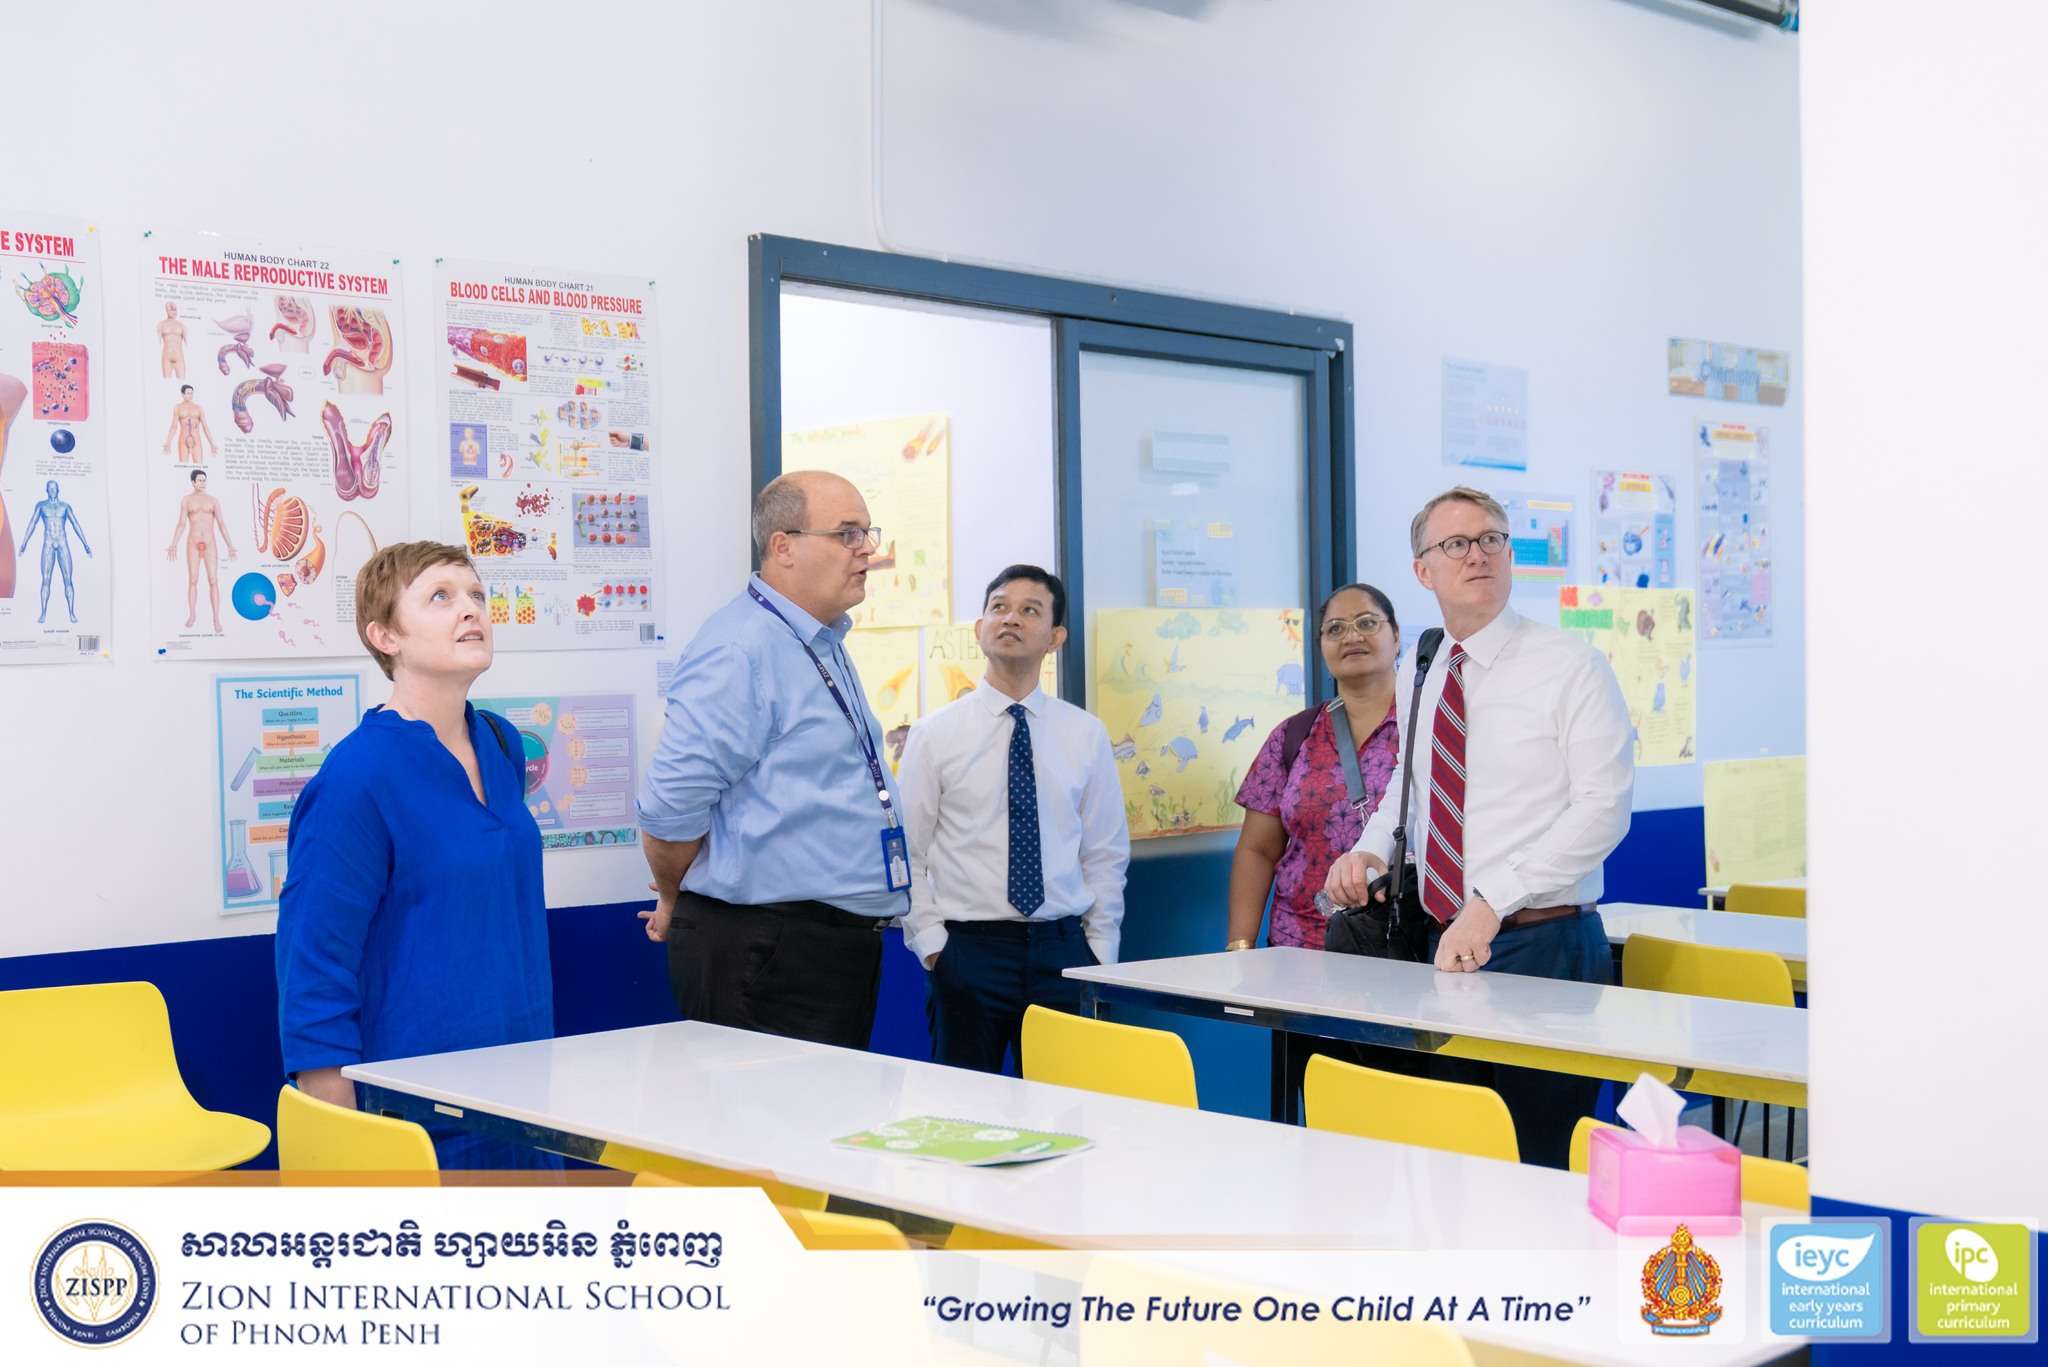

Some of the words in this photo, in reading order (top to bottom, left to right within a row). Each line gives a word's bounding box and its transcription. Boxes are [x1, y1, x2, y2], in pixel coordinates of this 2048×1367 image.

[15, 231, 75, 257] SYSTEM
[224, 251, 258, 264] HUMAN
[260, 254, 285, 265] BODY
[287, 257, 318, 268] CHART
[319, 260, 329, 270] 22
[159, 256, 188, 276] THE
[192, 260, 229, 281] MALE
[234, 263, 335, 290] REPRODUCTIVE
[338, 273, 388, 295] SYSTEM
[504, 276, 534, 287] HUMAN
[535, 279, 556, 288] BODY
[559, 282, 584, 291] CHART
[585, 284, 594, 292] 21
[450, 281, 488, 300] BLOOD
[491, 286, 525, 304] CELLS
[528, 290, 550, 305] AND
[553, 291, 588, 309] BLOOD
[591, 296, 642, 314] PRESSURE
[234, 689, 253, 699] The
[256, 687, 303, 700] Scientific
[306, 686, 343, 697] Method
